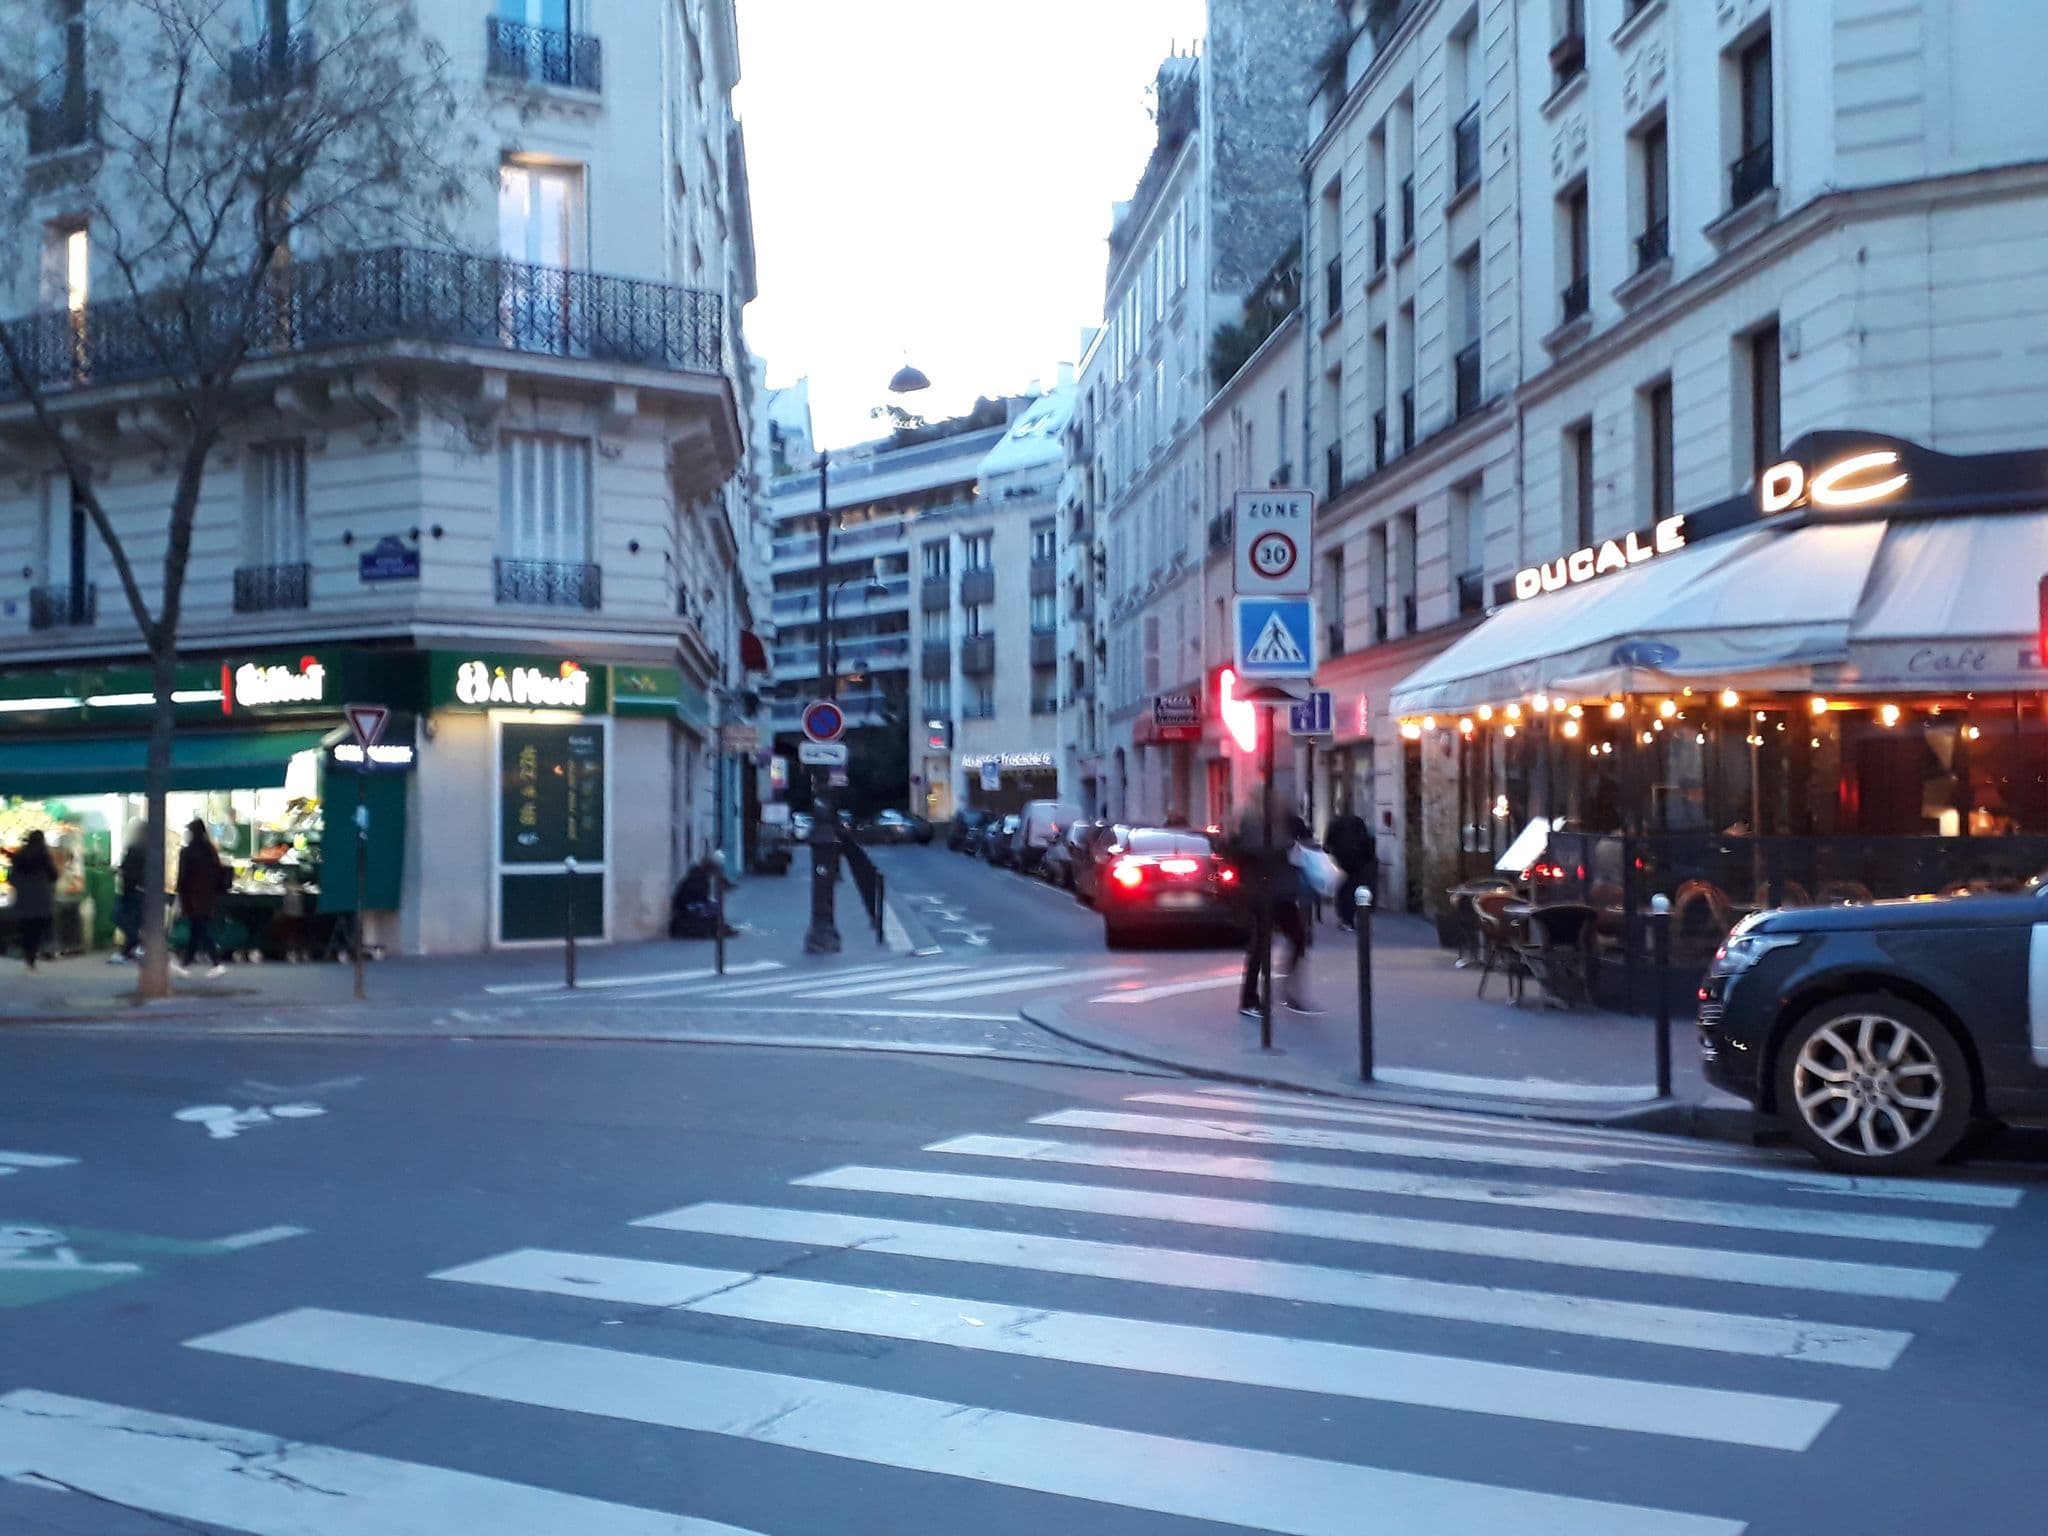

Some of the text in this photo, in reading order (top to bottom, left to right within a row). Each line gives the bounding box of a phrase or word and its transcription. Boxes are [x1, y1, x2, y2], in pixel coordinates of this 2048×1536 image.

[1248, 503, 1300, 519] ZONE
[1260, 544, 1287, 565] 30
[1514, 513, 1689, 601] DUCALE
